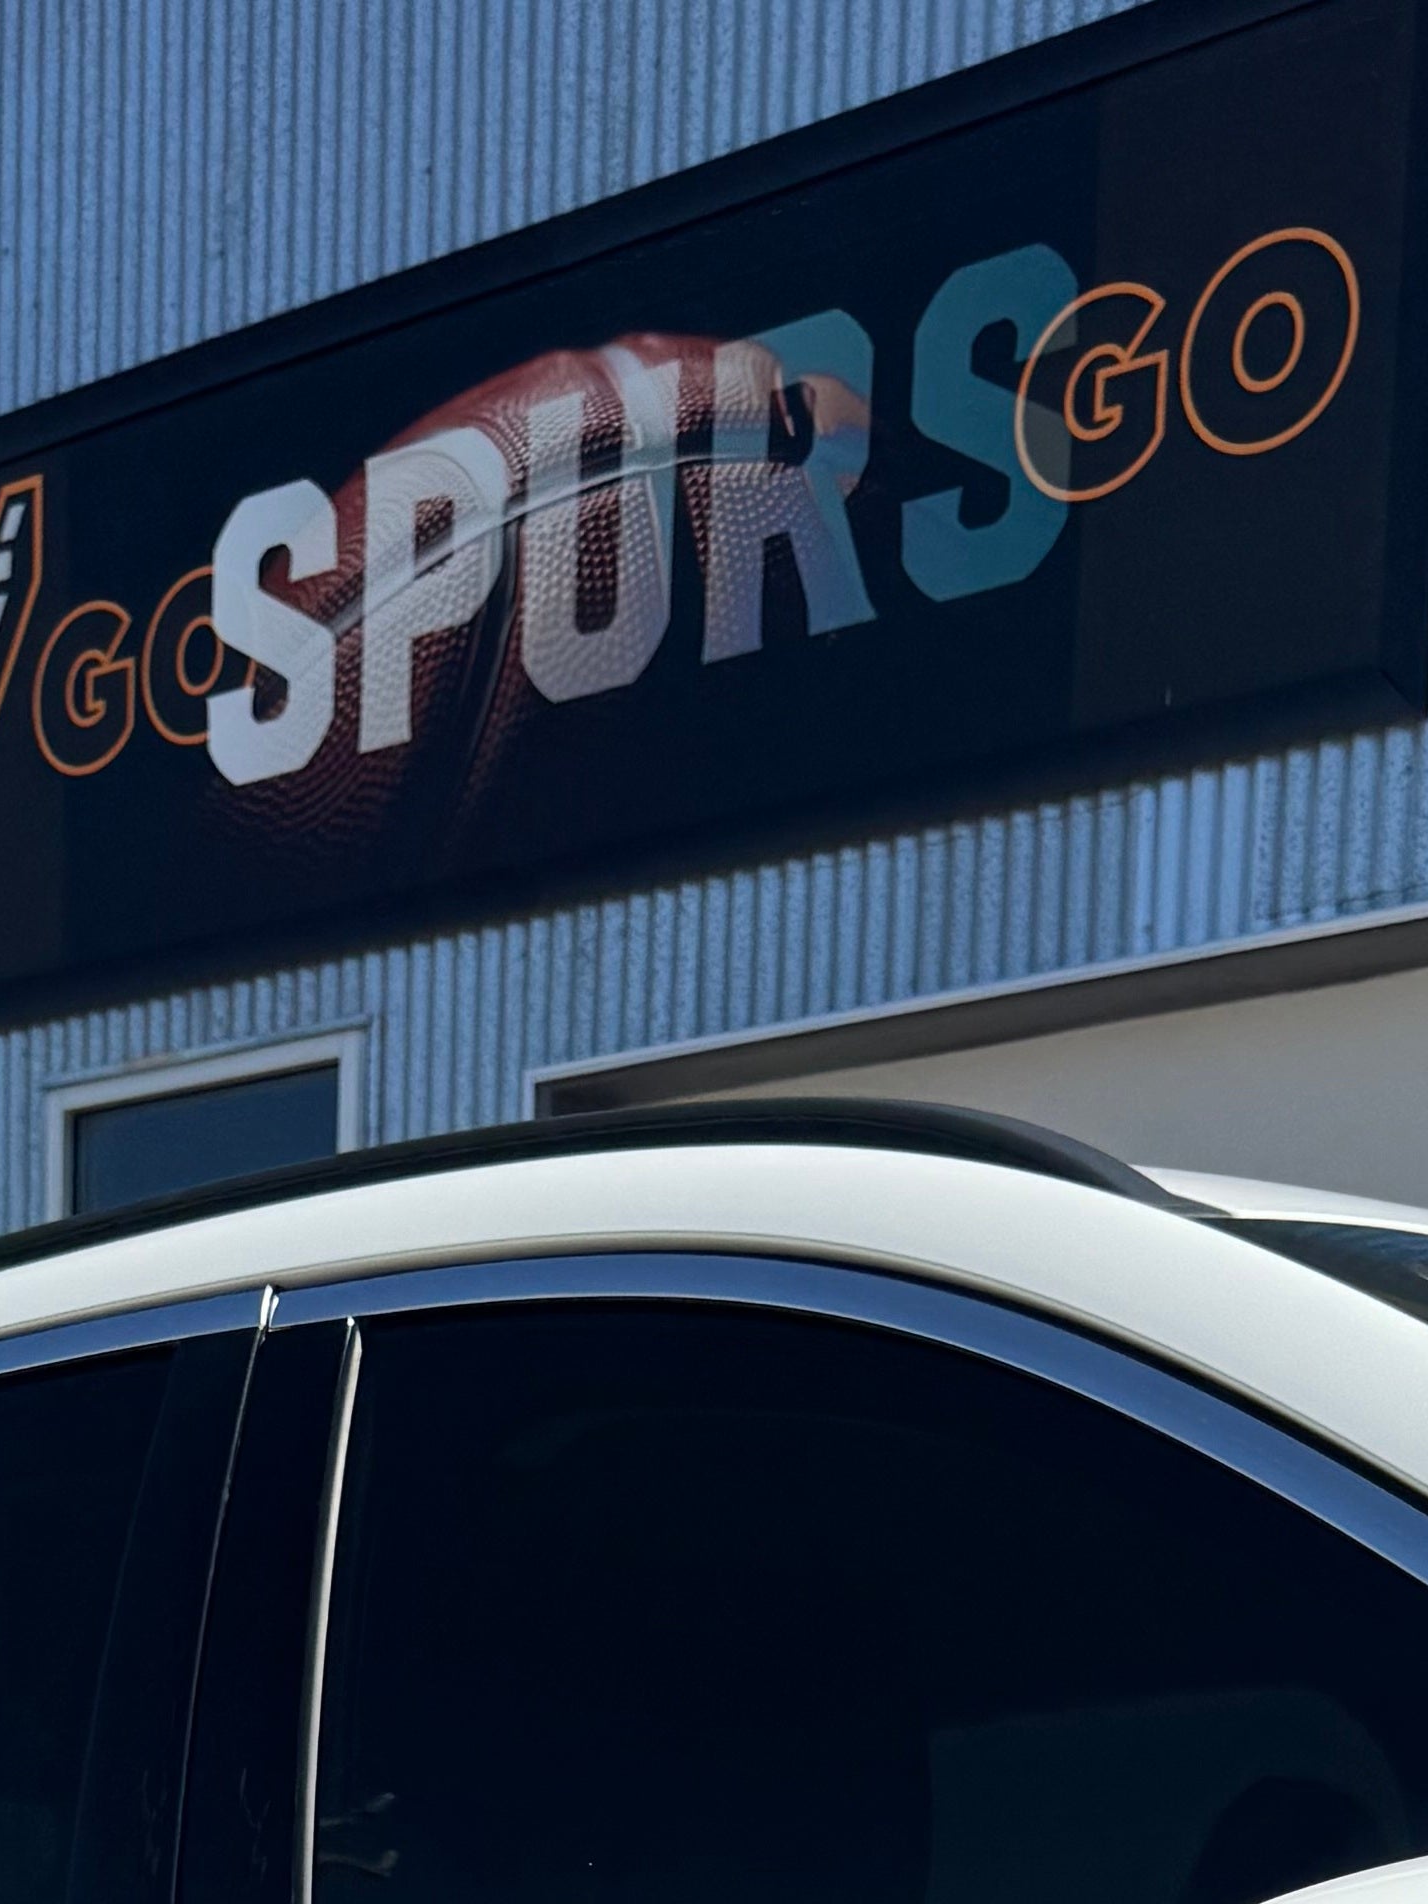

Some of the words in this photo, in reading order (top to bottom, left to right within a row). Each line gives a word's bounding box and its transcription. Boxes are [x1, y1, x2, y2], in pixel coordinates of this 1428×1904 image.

[32, 564, 257, 777] GO
[205, 243, 1080, 787] SPURS
[1014, 227, 1361, 503] GO
